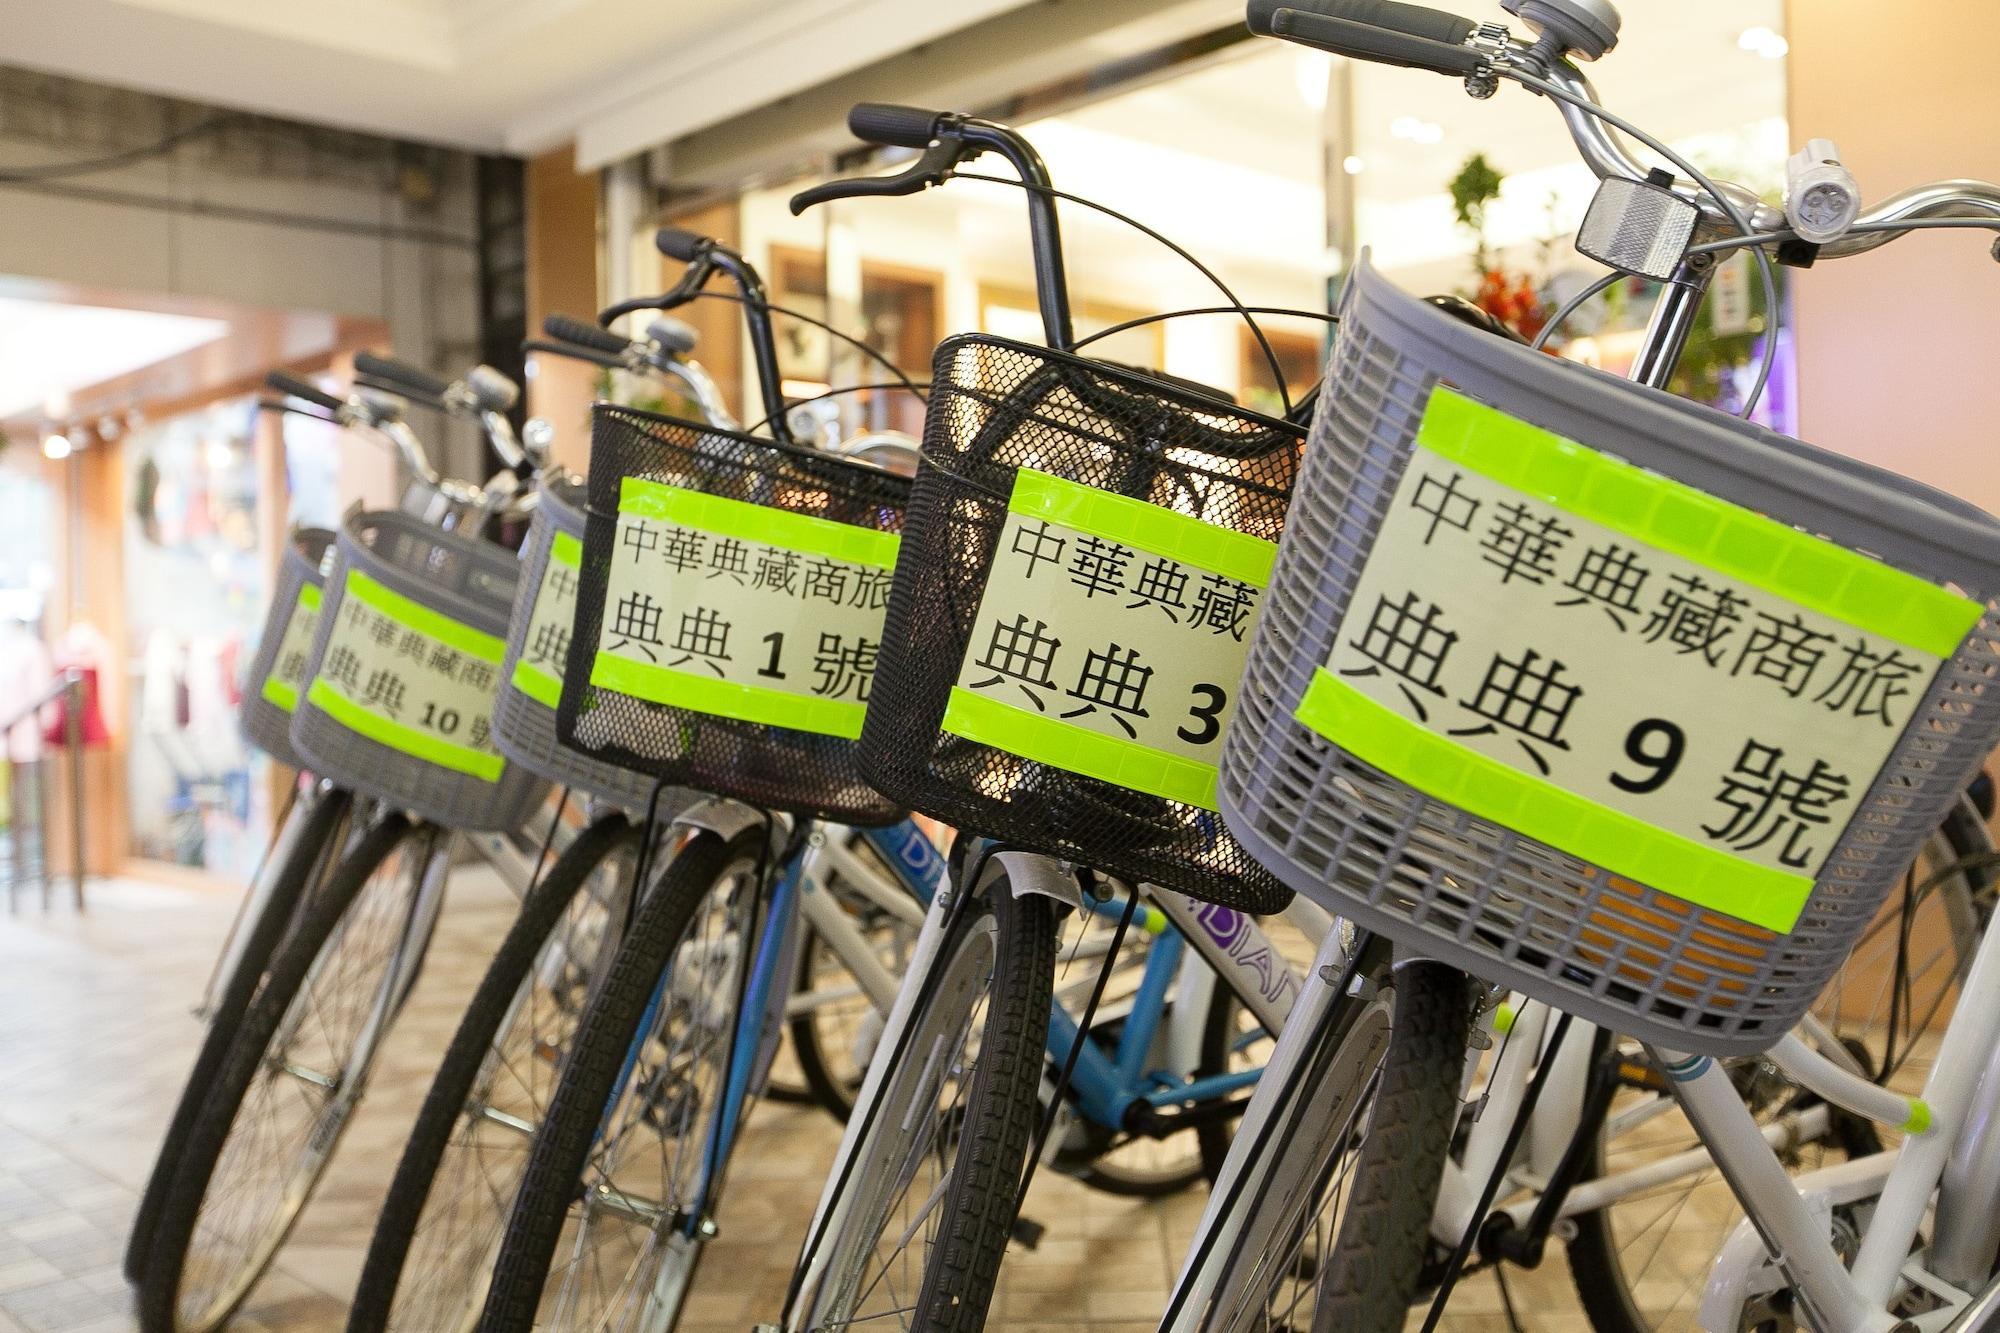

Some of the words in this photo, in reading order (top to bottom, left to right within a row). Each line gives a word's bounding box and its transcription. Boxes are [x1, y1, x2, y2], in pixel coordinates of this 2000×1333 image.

[622, 519, 894, 612] 中華典藏商旅
[1409, 471, 1925, 728] 中華典藏商旅
[608, 590, 733, 679] 典典
[757, 631, 786, 681] 1
[811, 631, 880, 703] 號
[968, 612, 1155, 740] 典典
[1176, 682, 1228, 745] 3
[419, 701, 460, 735] 10
[1338, 590, 1584, 776] 典典
[1607, 716, 1687, 794] 9
[1700, 737, 1851, 869] 號
